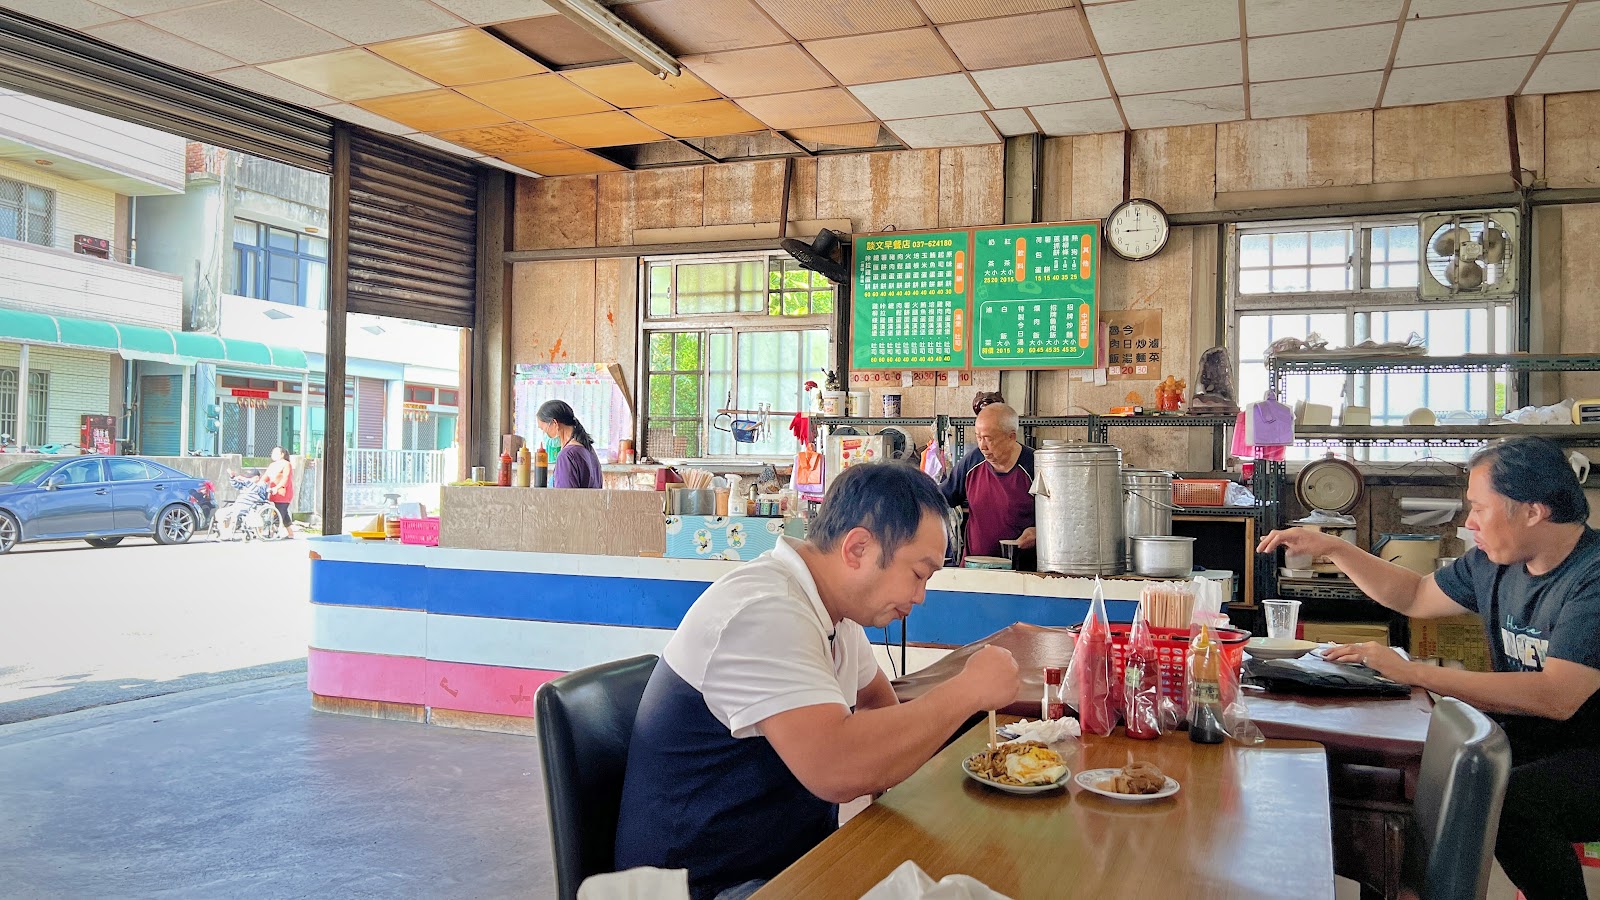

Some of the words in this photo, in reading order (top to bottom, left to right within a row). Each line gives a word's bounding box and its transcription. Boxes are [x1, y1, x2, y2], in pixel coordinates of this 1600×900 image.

[1000, 306, 1007, 339] 白飯
[1122, 325, 1133, 363] 今日湯
[1136, 339, 1146, 362] 炒麵
[938, 373, 947, 381] 15
